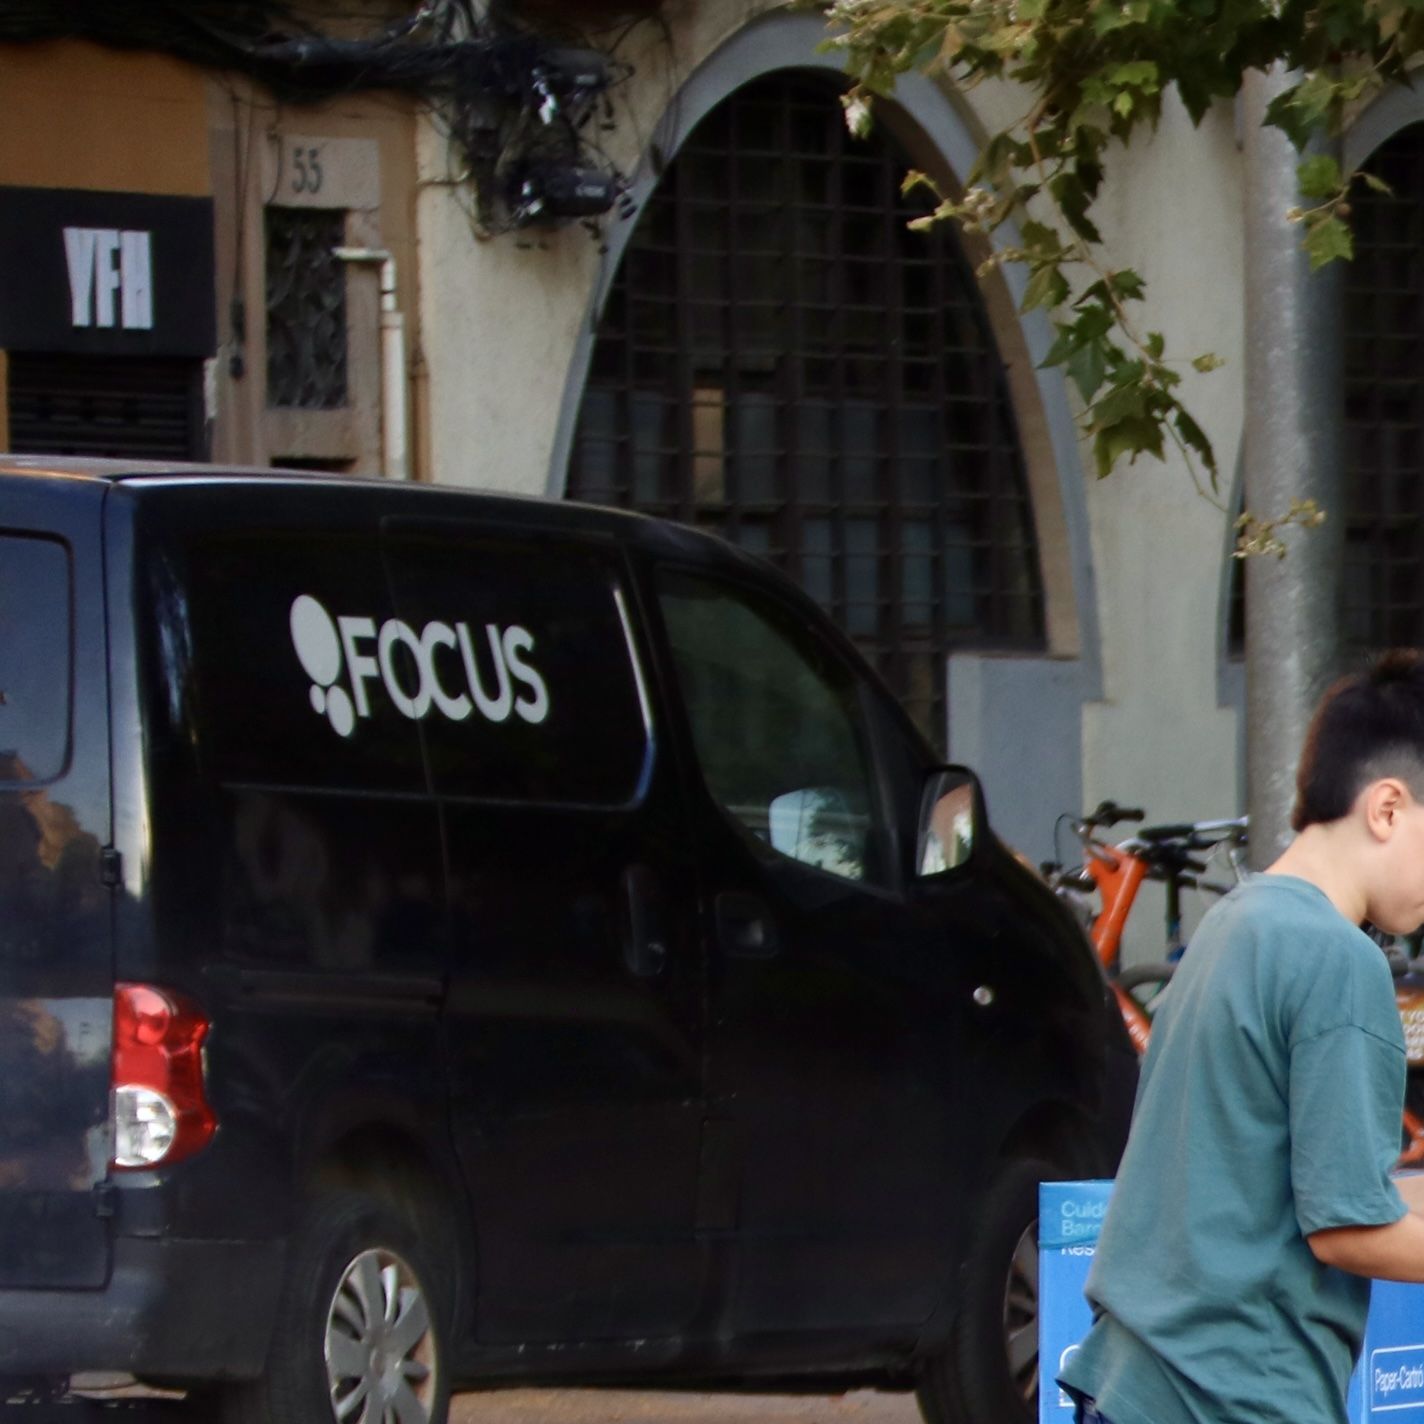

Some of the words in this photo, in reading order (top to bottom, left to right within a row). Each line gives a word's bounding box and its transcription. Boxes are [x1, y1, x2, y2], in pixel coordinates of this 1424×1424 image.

[291, 147, 323, 194] 55
[337, 615, 549, 724] FOCUS
[1062, 1201, 1107, 1217] Cuid
[1375, 1364, 1424, 1397] Paper-Cartó
